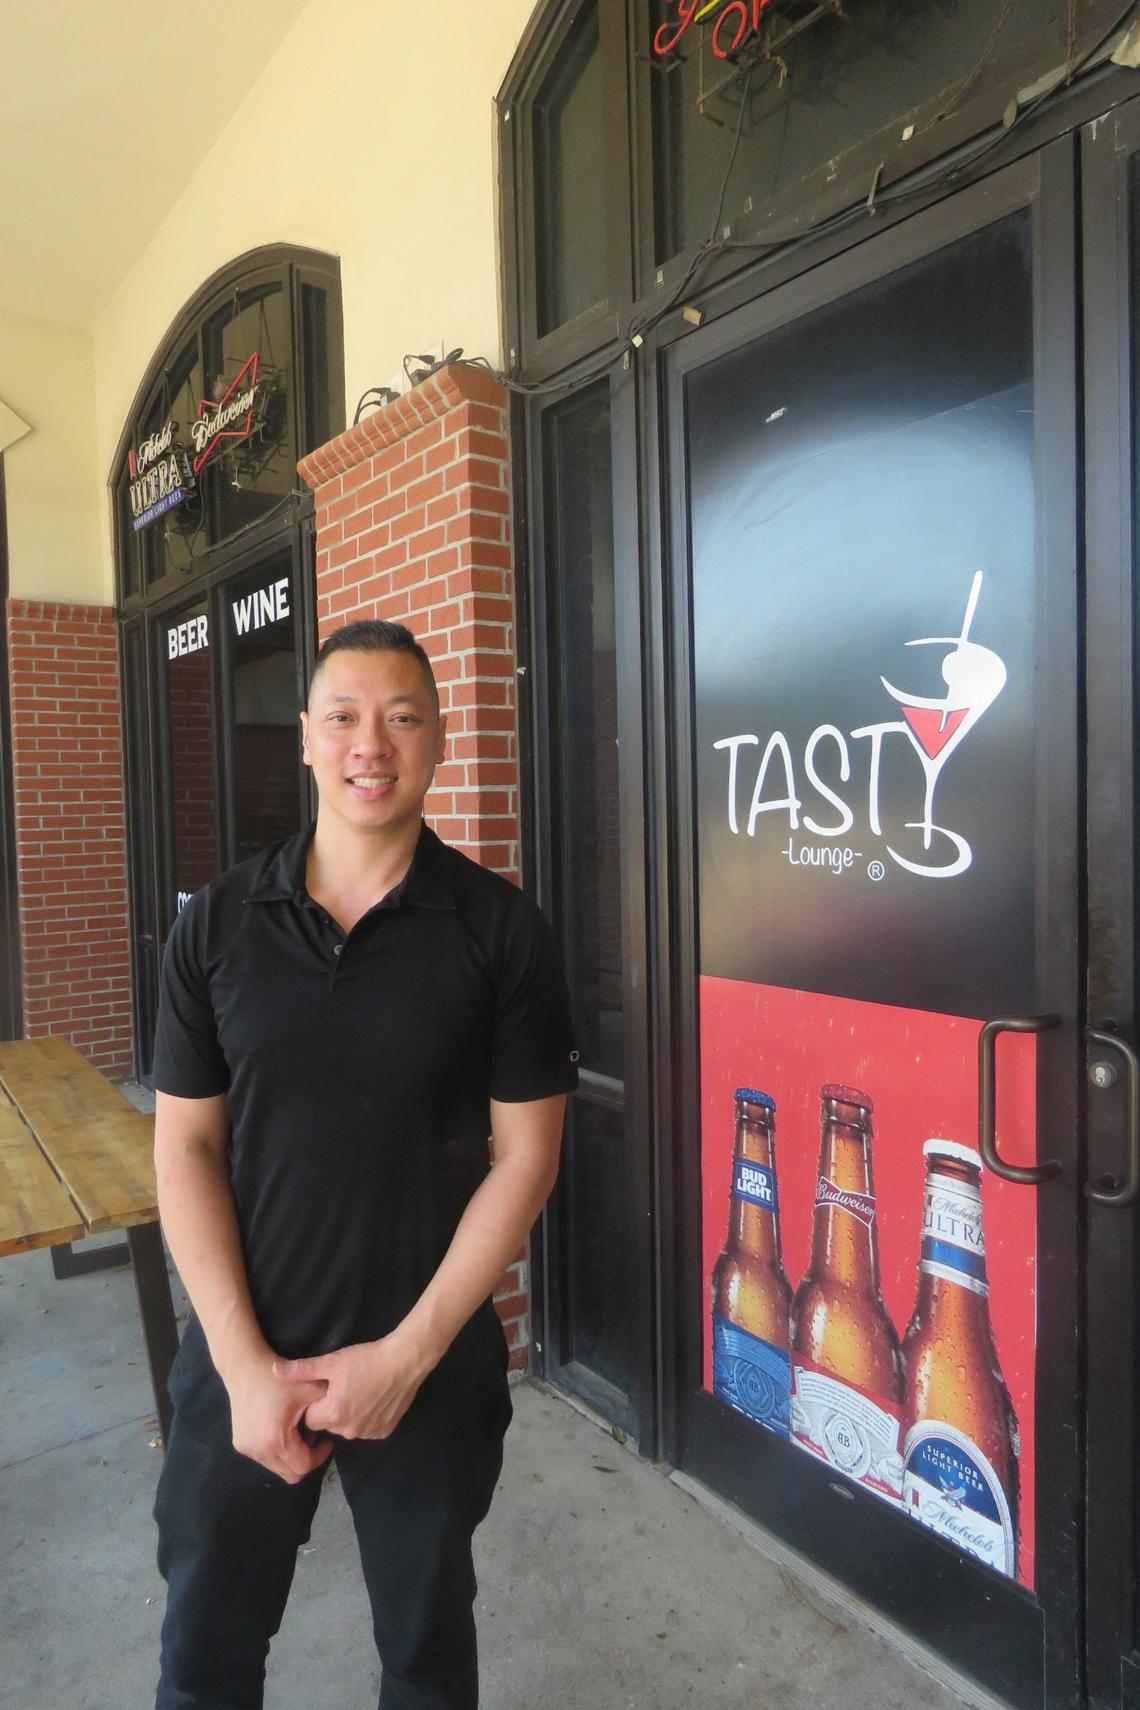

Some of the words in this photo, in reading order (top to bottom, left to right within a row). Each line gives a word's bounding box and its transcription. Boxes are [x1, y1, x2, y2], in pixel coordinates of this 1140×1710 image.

[192, 386, 259, 452] Budweiser
[129, 454, 182, 517] ULTRA
[167, 614, 209, 661] BEER
[232, 577, 290, 636] WINE
[713, 636, 1007, 878] TASTY
[737, 1178, 772, 1201] LIGHT
[741, 1167, 767, 1186] BUD
[816, 1183, 876, 1217] Budweiser
[924, 1209, 985, 1246] ULTRA
[922, 1451, 952, 1473] LIGHT
[958, 1471, 984, 1492] BEER
[927, 1445, 979, 1480] SUPERIOR
[922, 1500, 995, 1553] Michelob
